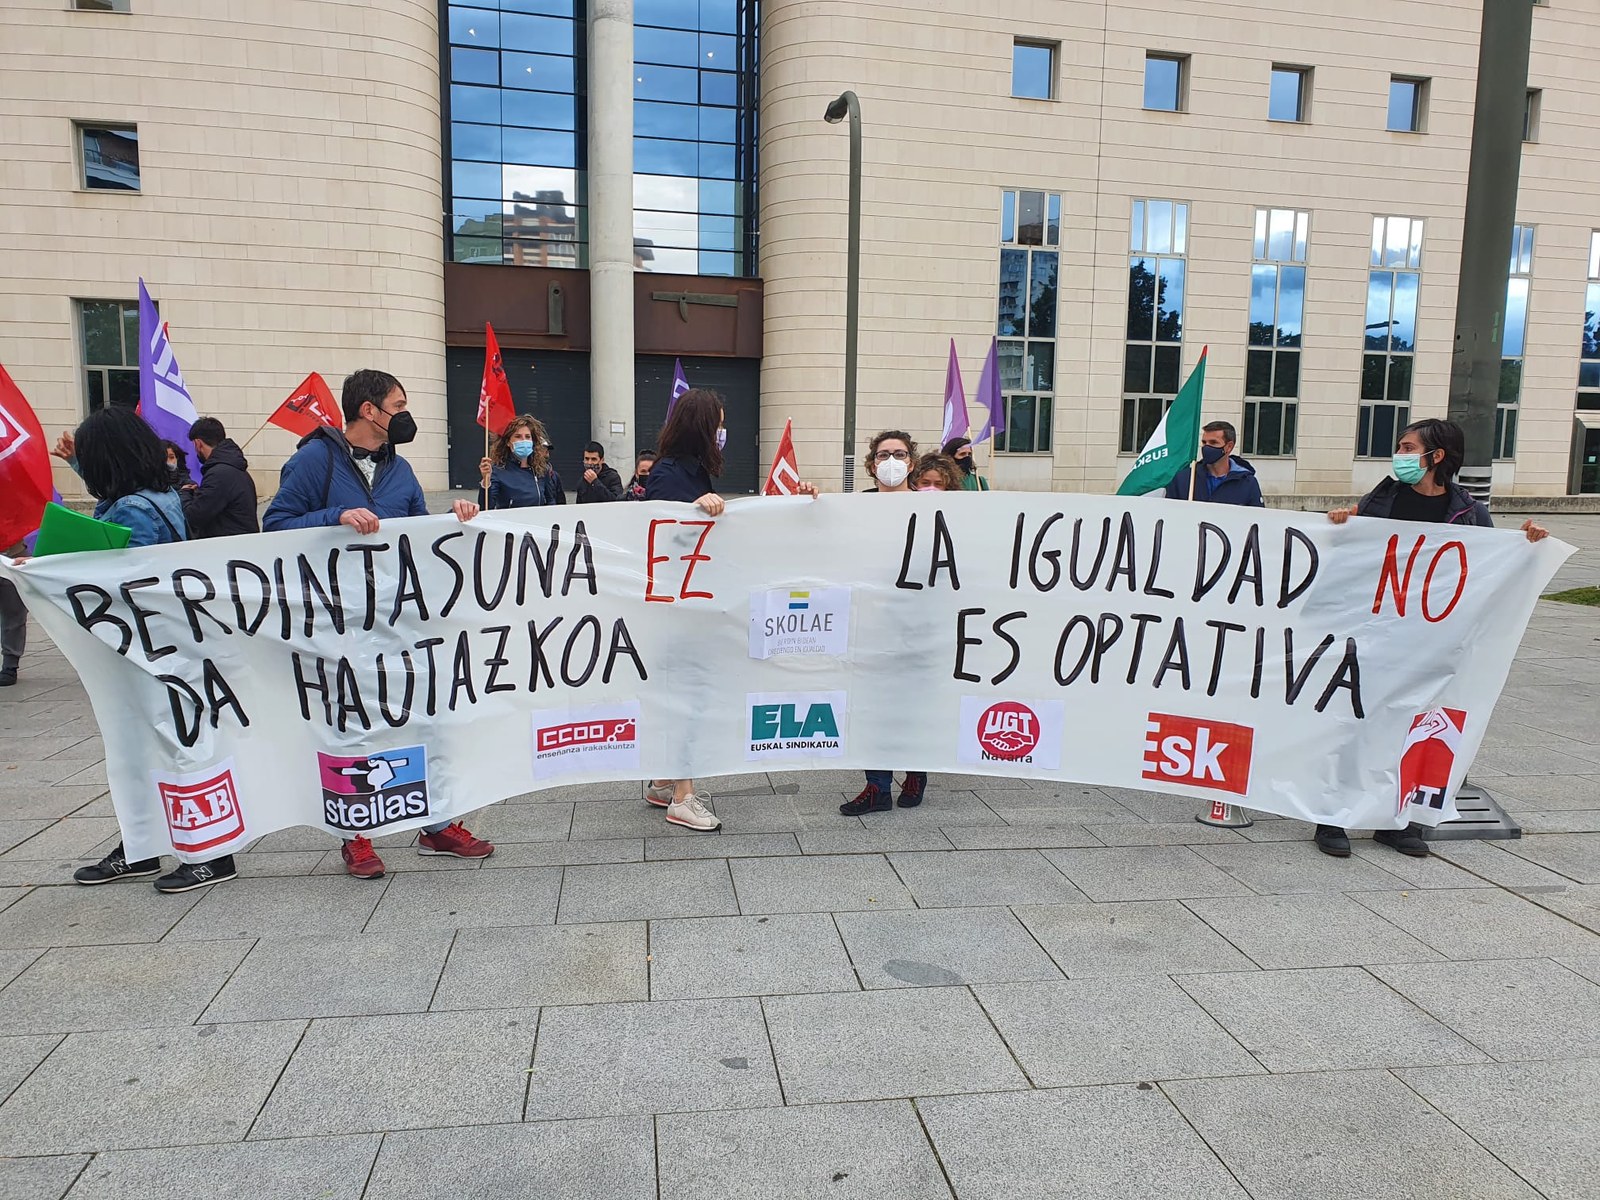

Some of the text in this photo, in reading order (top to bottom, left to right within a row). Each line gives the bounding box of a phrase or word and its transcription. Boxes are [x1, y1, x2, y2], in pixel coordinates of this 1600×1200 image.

[895, 510, 1469, 624] LA IGUALDAD NO
[65, 519, 716, 662] BERDINTASUNA EZ
[764, 613, 834, 637] SKOLAE
[158, 615, 648, 748] DA HAUTAZKOA
[953, 608, 1365, 719] ES OPTATIVA
[543, 724, 604, 747] CCOO
[752, 703, 840, 740] ELA
[985, 711, 1032, 735] UGT
[537, 743, 635, 759] enseñanza irakaskuntza
[750, 741, 839, 751] EUSKAL SINDIKATUA
[982, 750, 1033, 763] Navarra
[167, 788, 232, 827] LAB
[326, 790, 427, 828] steilas
